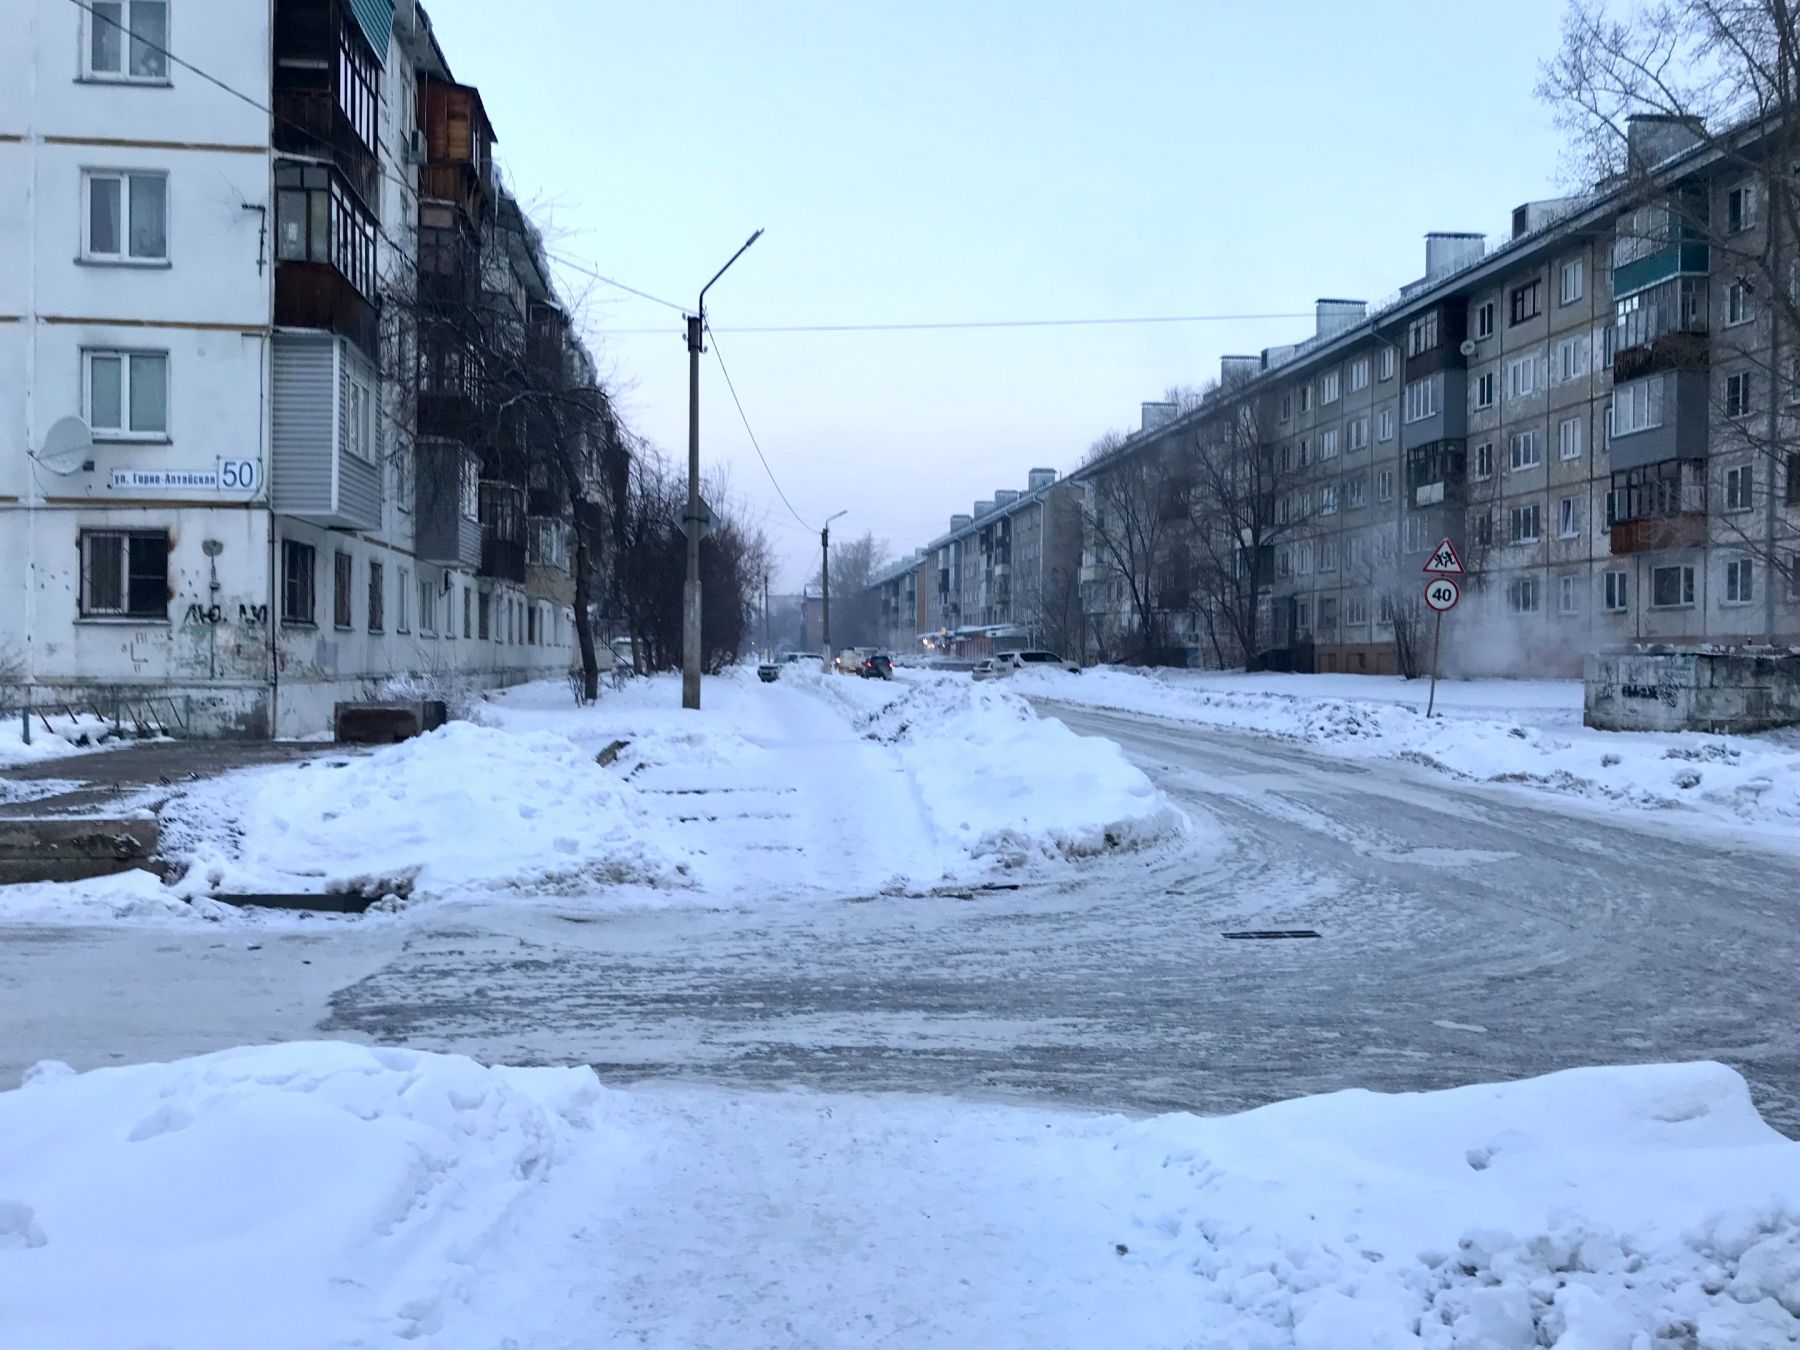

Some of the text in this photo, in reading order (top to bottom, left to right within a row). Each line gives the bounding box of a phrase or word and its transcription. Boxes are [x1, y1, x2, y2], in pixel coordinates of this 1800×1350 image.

[114, 473, 129, 486] ул.
[222, 461, 254, 488] 50
[1432, 588, 1452, 602] 40
